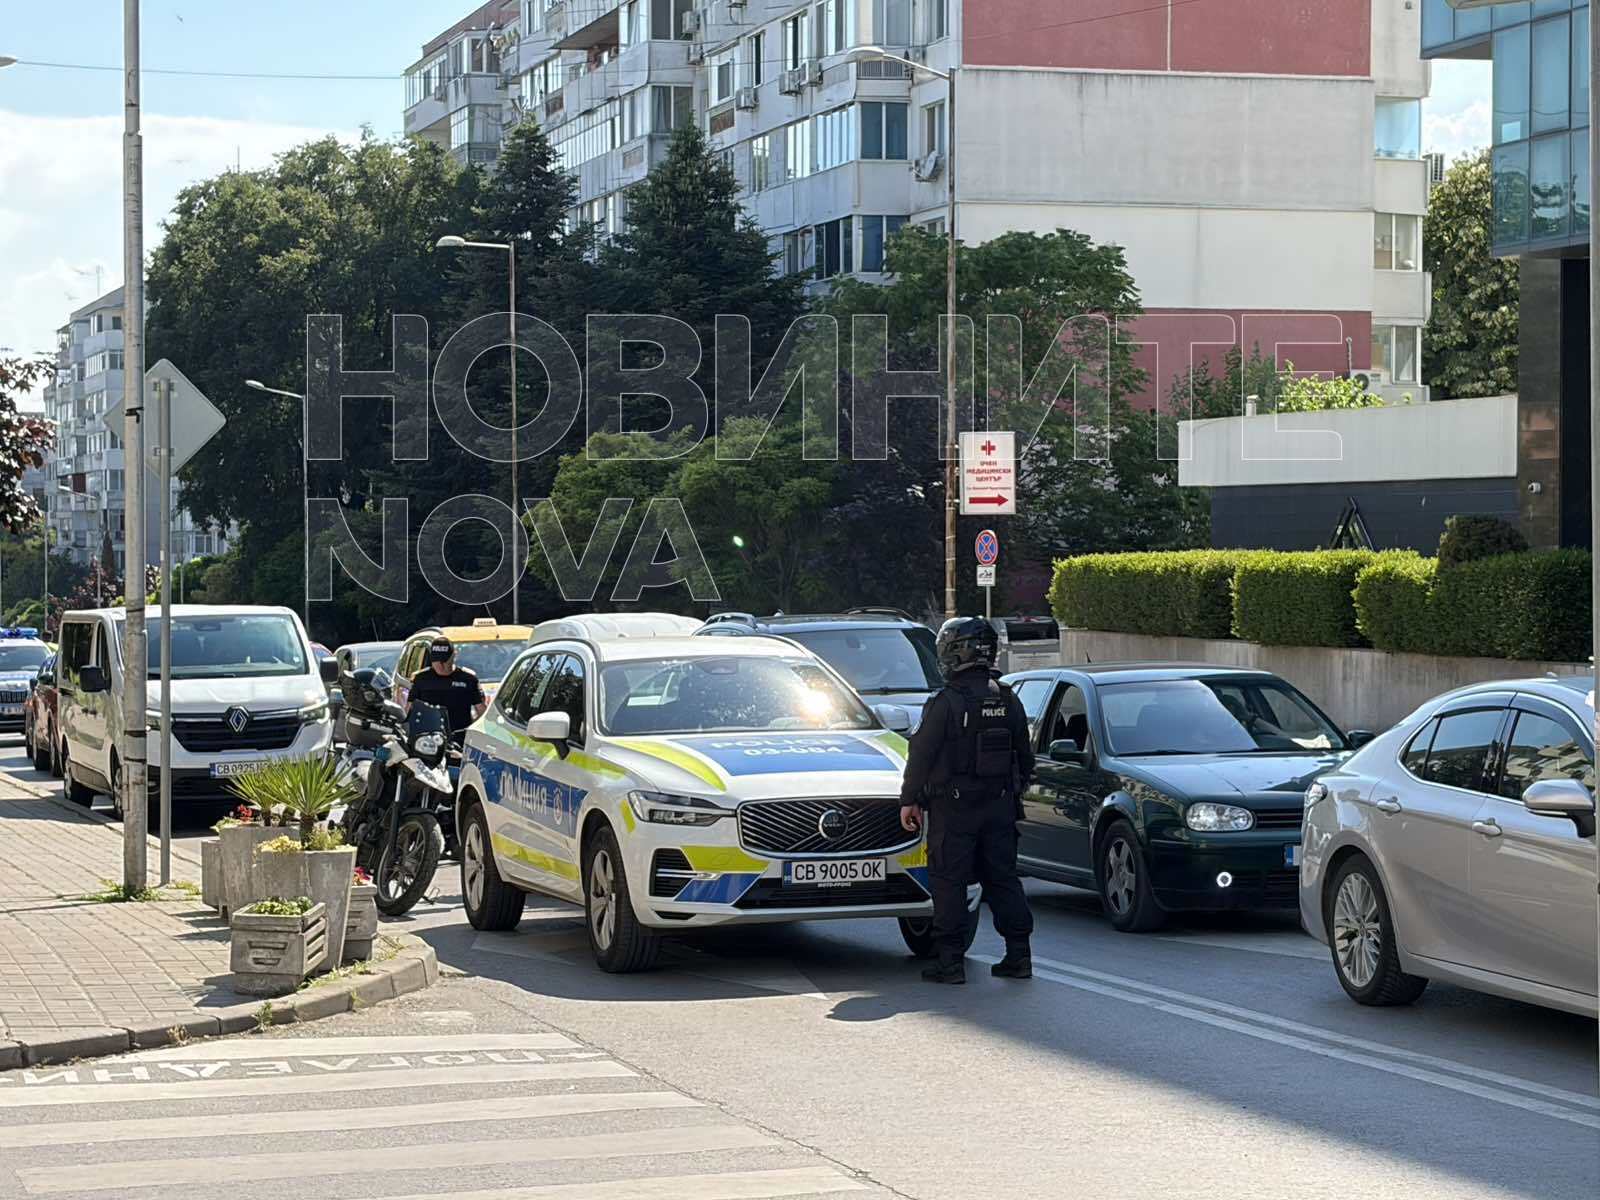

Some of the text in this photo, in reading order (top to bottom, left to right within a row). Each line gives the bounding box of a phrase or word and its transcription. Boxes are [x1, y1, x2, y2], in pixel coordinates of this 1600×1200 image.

[982, 707, 1006, 717] POLICE
[217, 764, 230, 774] CB
[795, 861, 882, 880] CB 9005 OK
